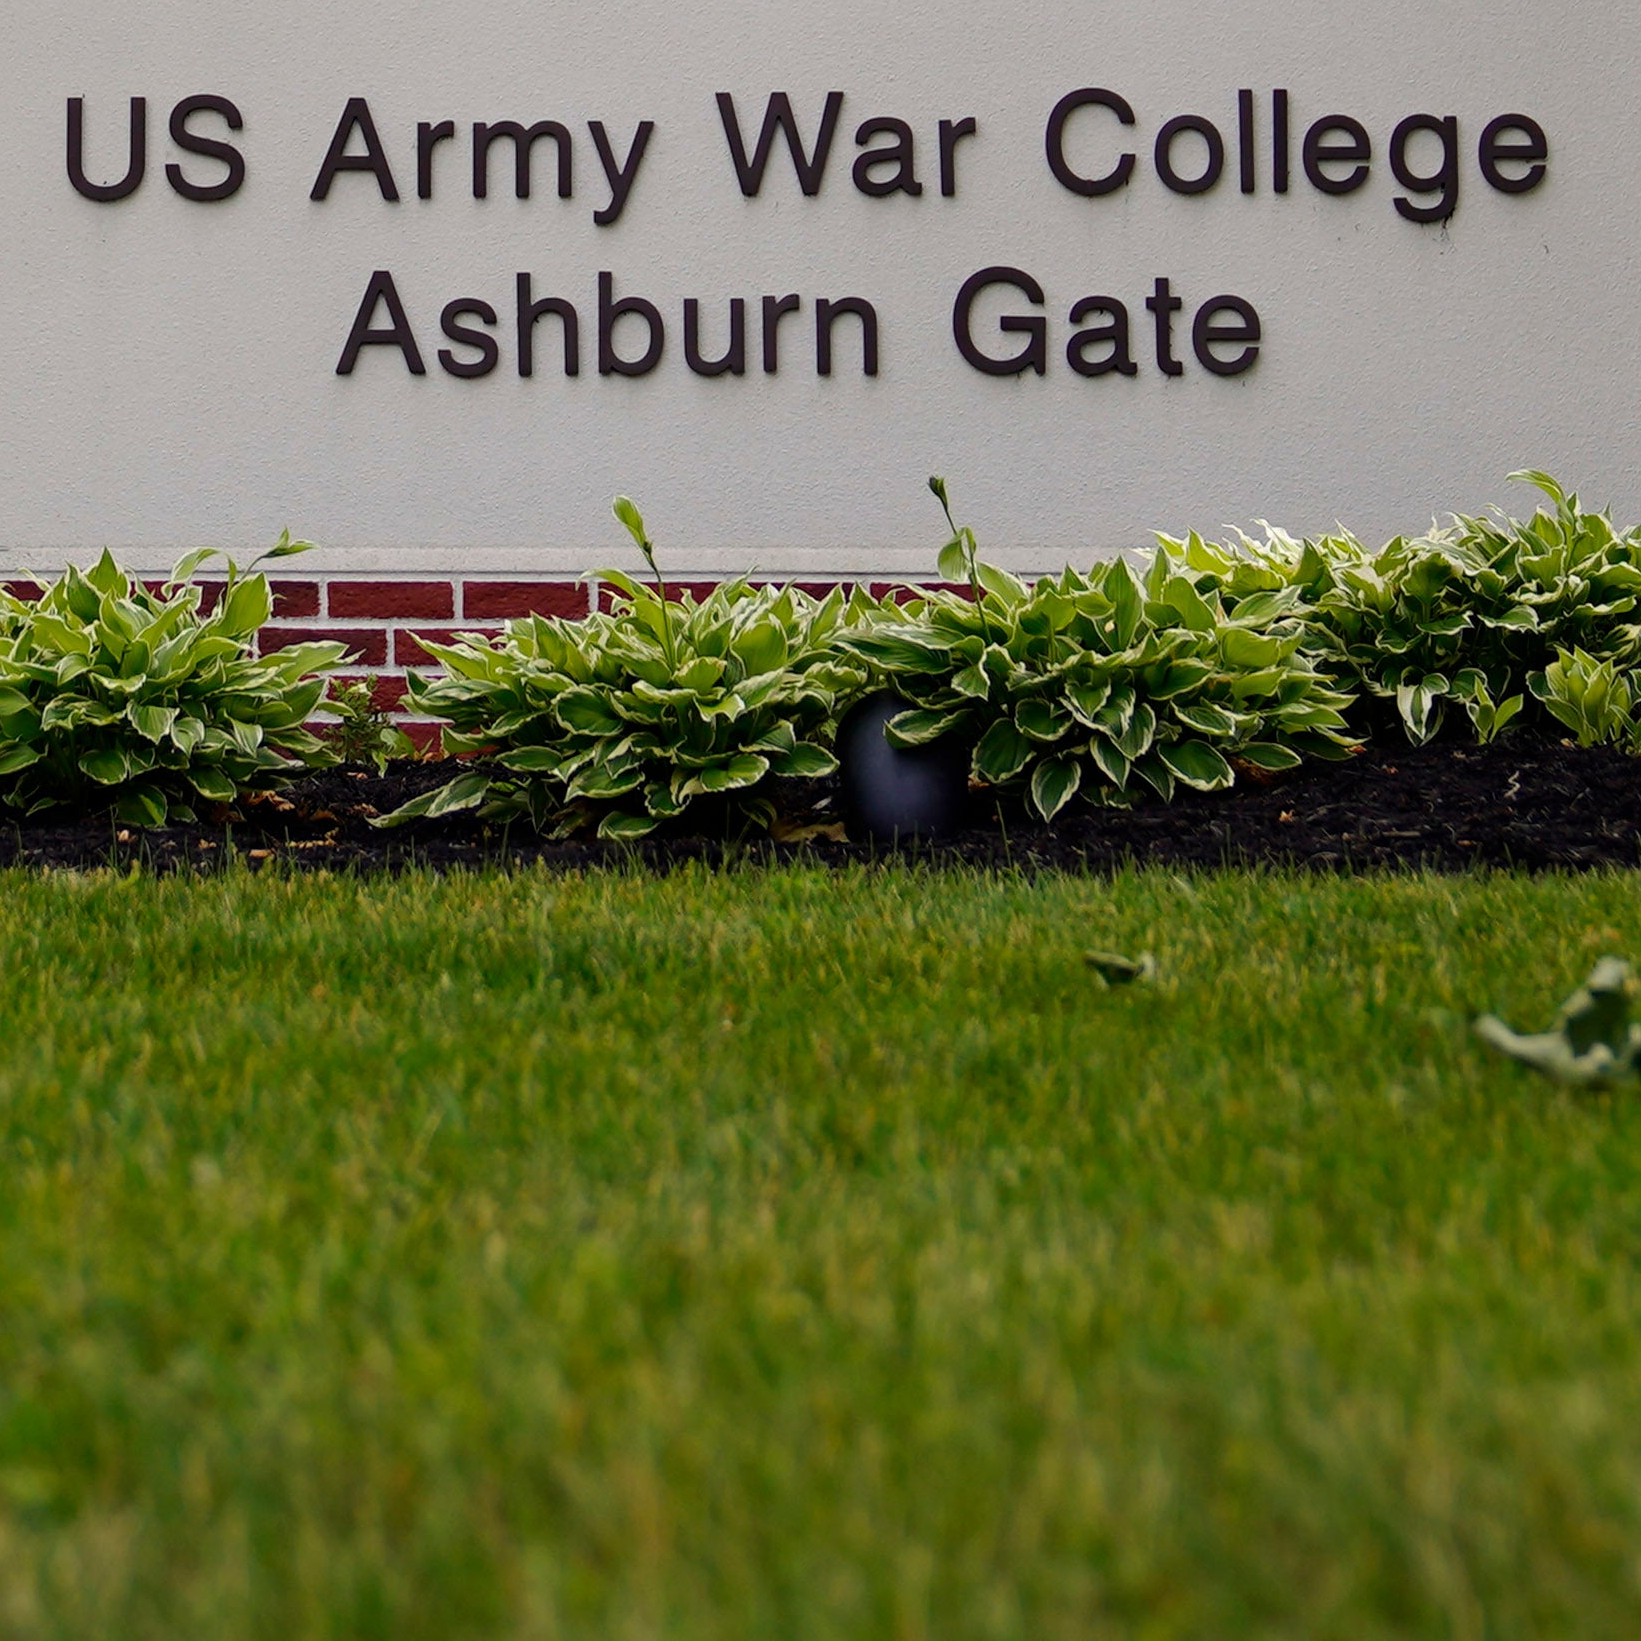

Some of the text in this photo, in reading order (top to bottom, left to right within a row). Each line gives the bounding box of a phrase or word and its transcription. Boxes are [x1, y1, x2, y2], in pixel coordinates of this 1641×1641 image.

[65, 86, 1550, 230] US Army War College
[334, 265, 1263, 382] Ashburn Gate
